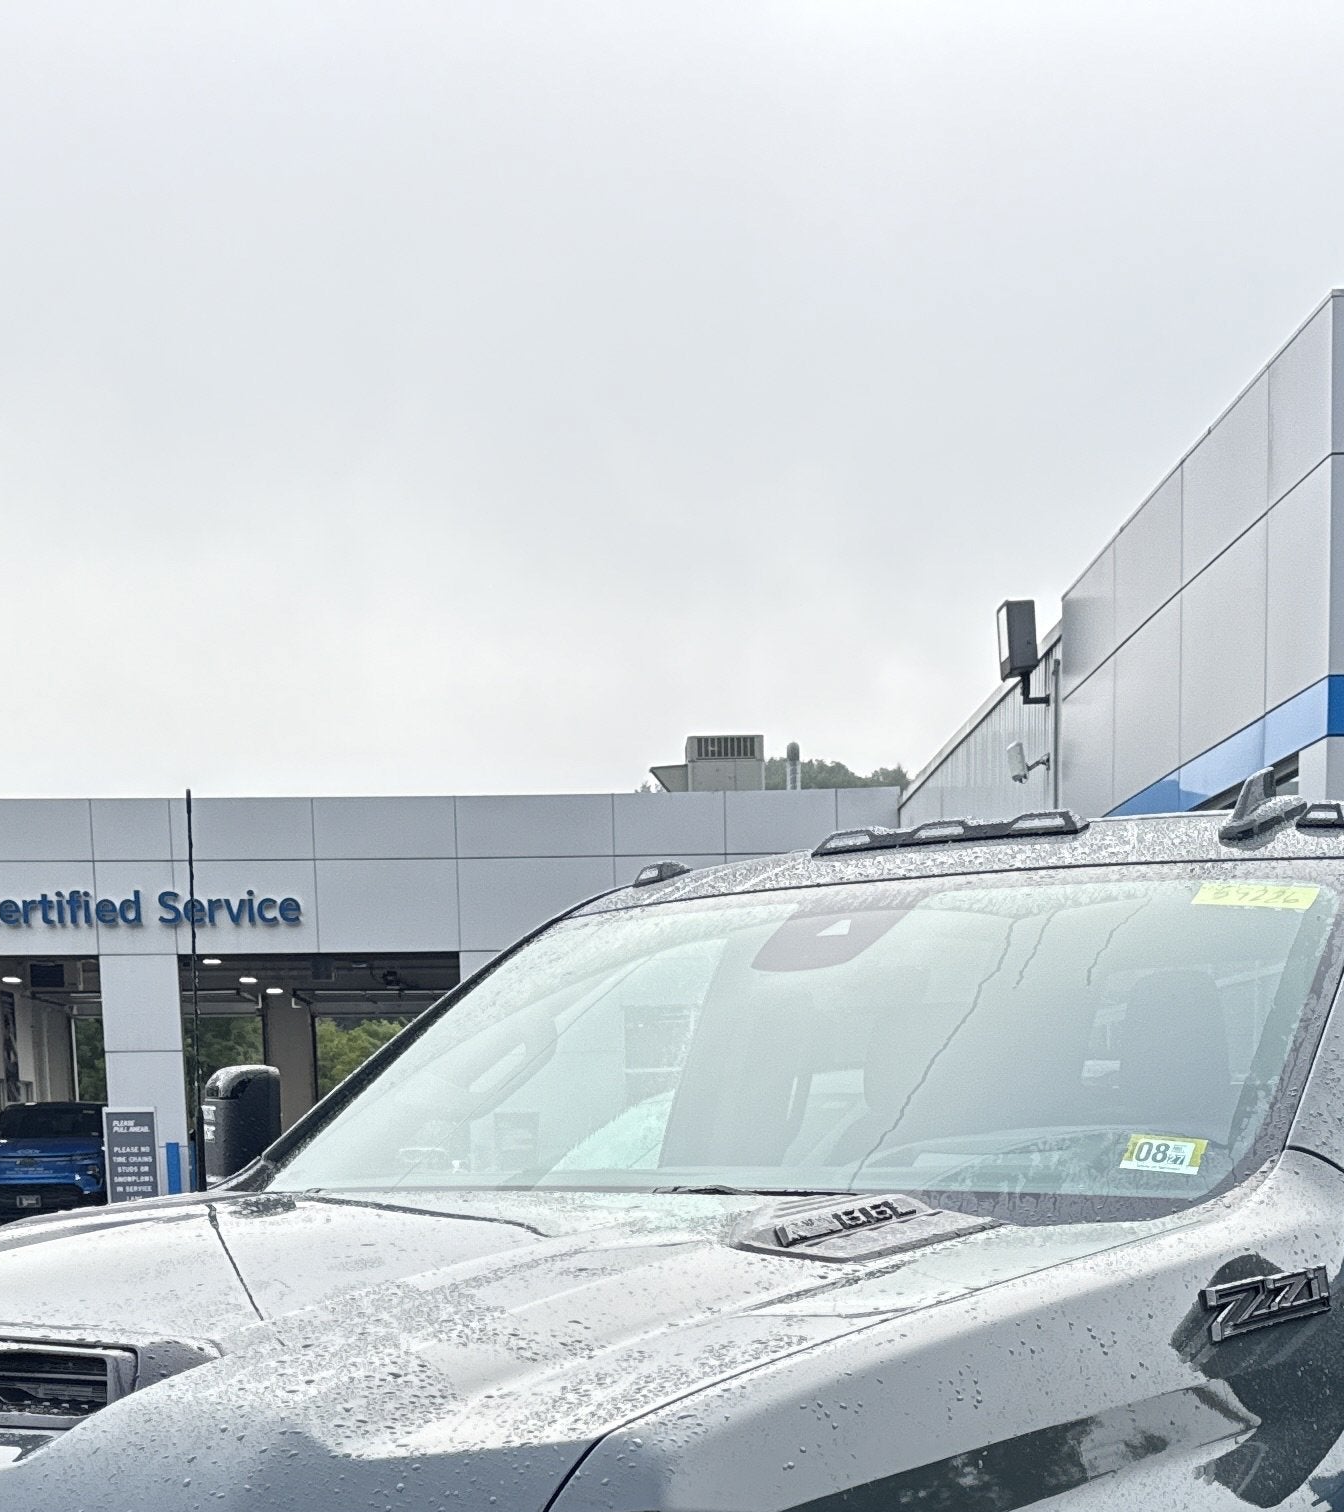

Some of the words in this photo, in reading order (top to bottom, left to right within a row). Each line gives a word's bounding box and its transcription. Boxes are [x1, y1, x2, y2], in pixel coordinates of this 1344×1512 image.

[157, 889, 303, 926] Service
[1135, 1141, 1170, 1163] 08
[1198, 1263, 1331, 1345] Z71
